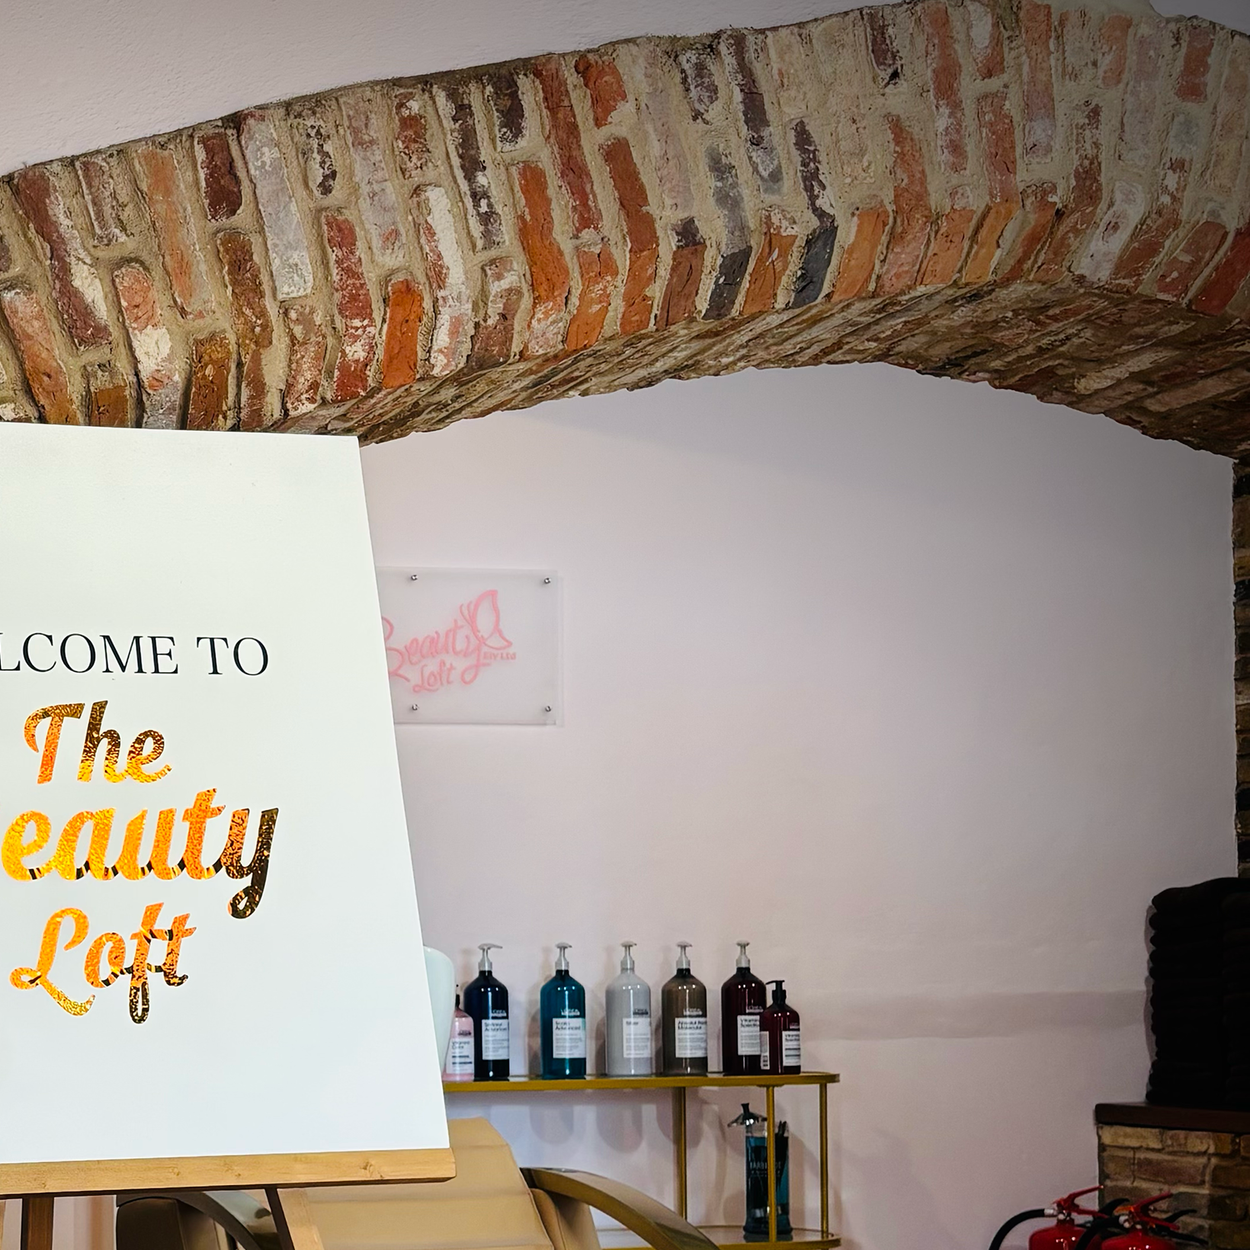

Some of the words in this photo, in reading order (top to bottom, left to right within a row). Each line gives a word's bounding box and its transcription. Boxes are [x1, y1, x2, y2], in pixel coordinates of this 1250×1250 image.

[196, 636, 269, 676] TO
[412, 659, 455, 694] Loft
[23, 700, 173, 785] The
[9, 902, 197, 1025] Loft
